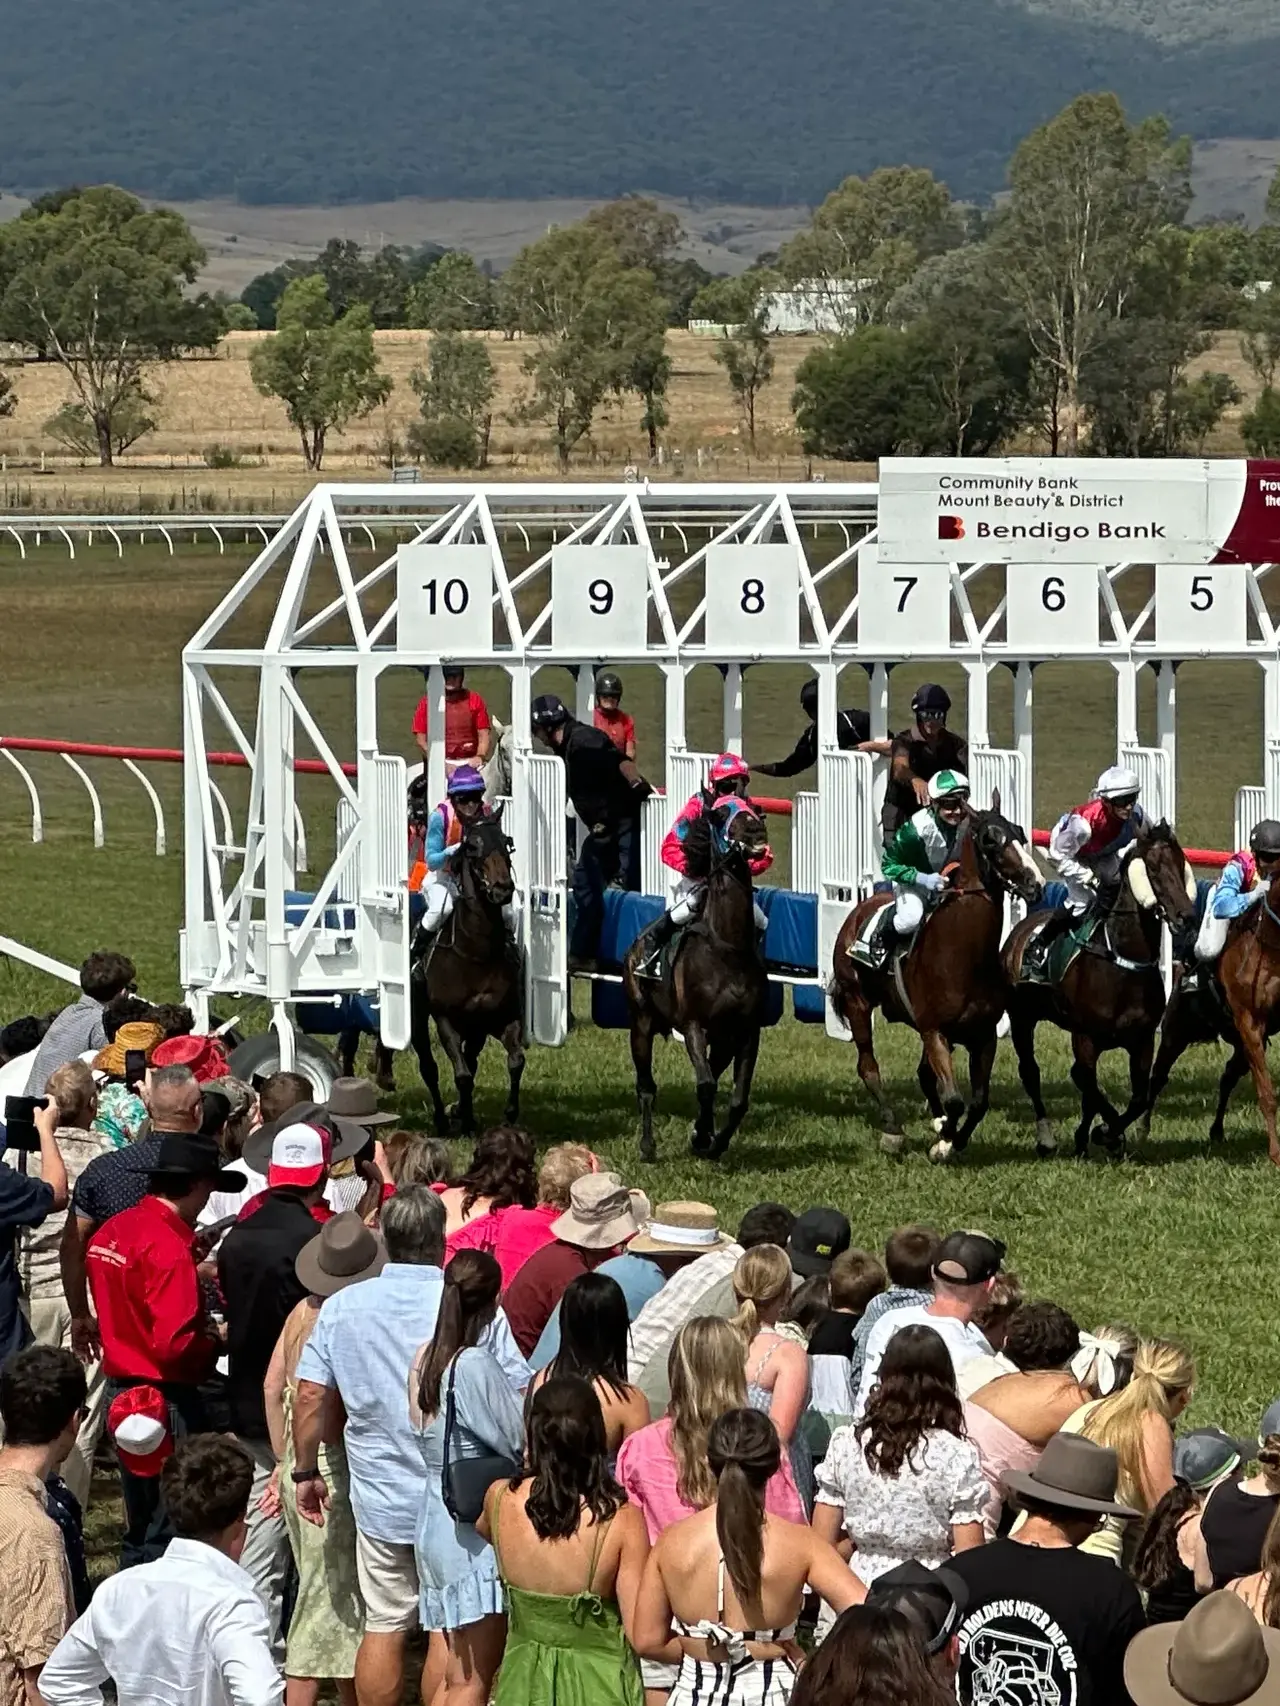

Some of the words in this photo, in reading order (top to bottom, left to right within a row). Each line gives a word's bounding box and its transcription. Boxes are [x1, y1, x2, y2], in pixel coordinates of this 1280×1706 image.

[938, 476, 1034, 492] Community
[1038, 476, 1079, 489] Bank
[938, 494, 990, 507] Mount
[994, 494, 1051, 510] Beauty
[1054, 495, 1065, 507] &
[1070, 494, 1125, 508] District
[977, 521, 1090, 543] Bendigo
[1098, 521, 1166, 539] Bank
[422, 578, 469, 615] 10
[588, 579, 614, 615] 9
[740, 578, 765, 614] 8
[893, 576, 918, 613] 7
[1041, 576, 1066, 612] 6
[1190, 576, 1214, 612] 5
[962, 1599, 1014, 1637] HOLDENS
[1014, 1599, 1051, 1631] NEVER
[1044, 1621, 1068, 1649] DIE
[1057, 1645, 1078, 1671] COZ
